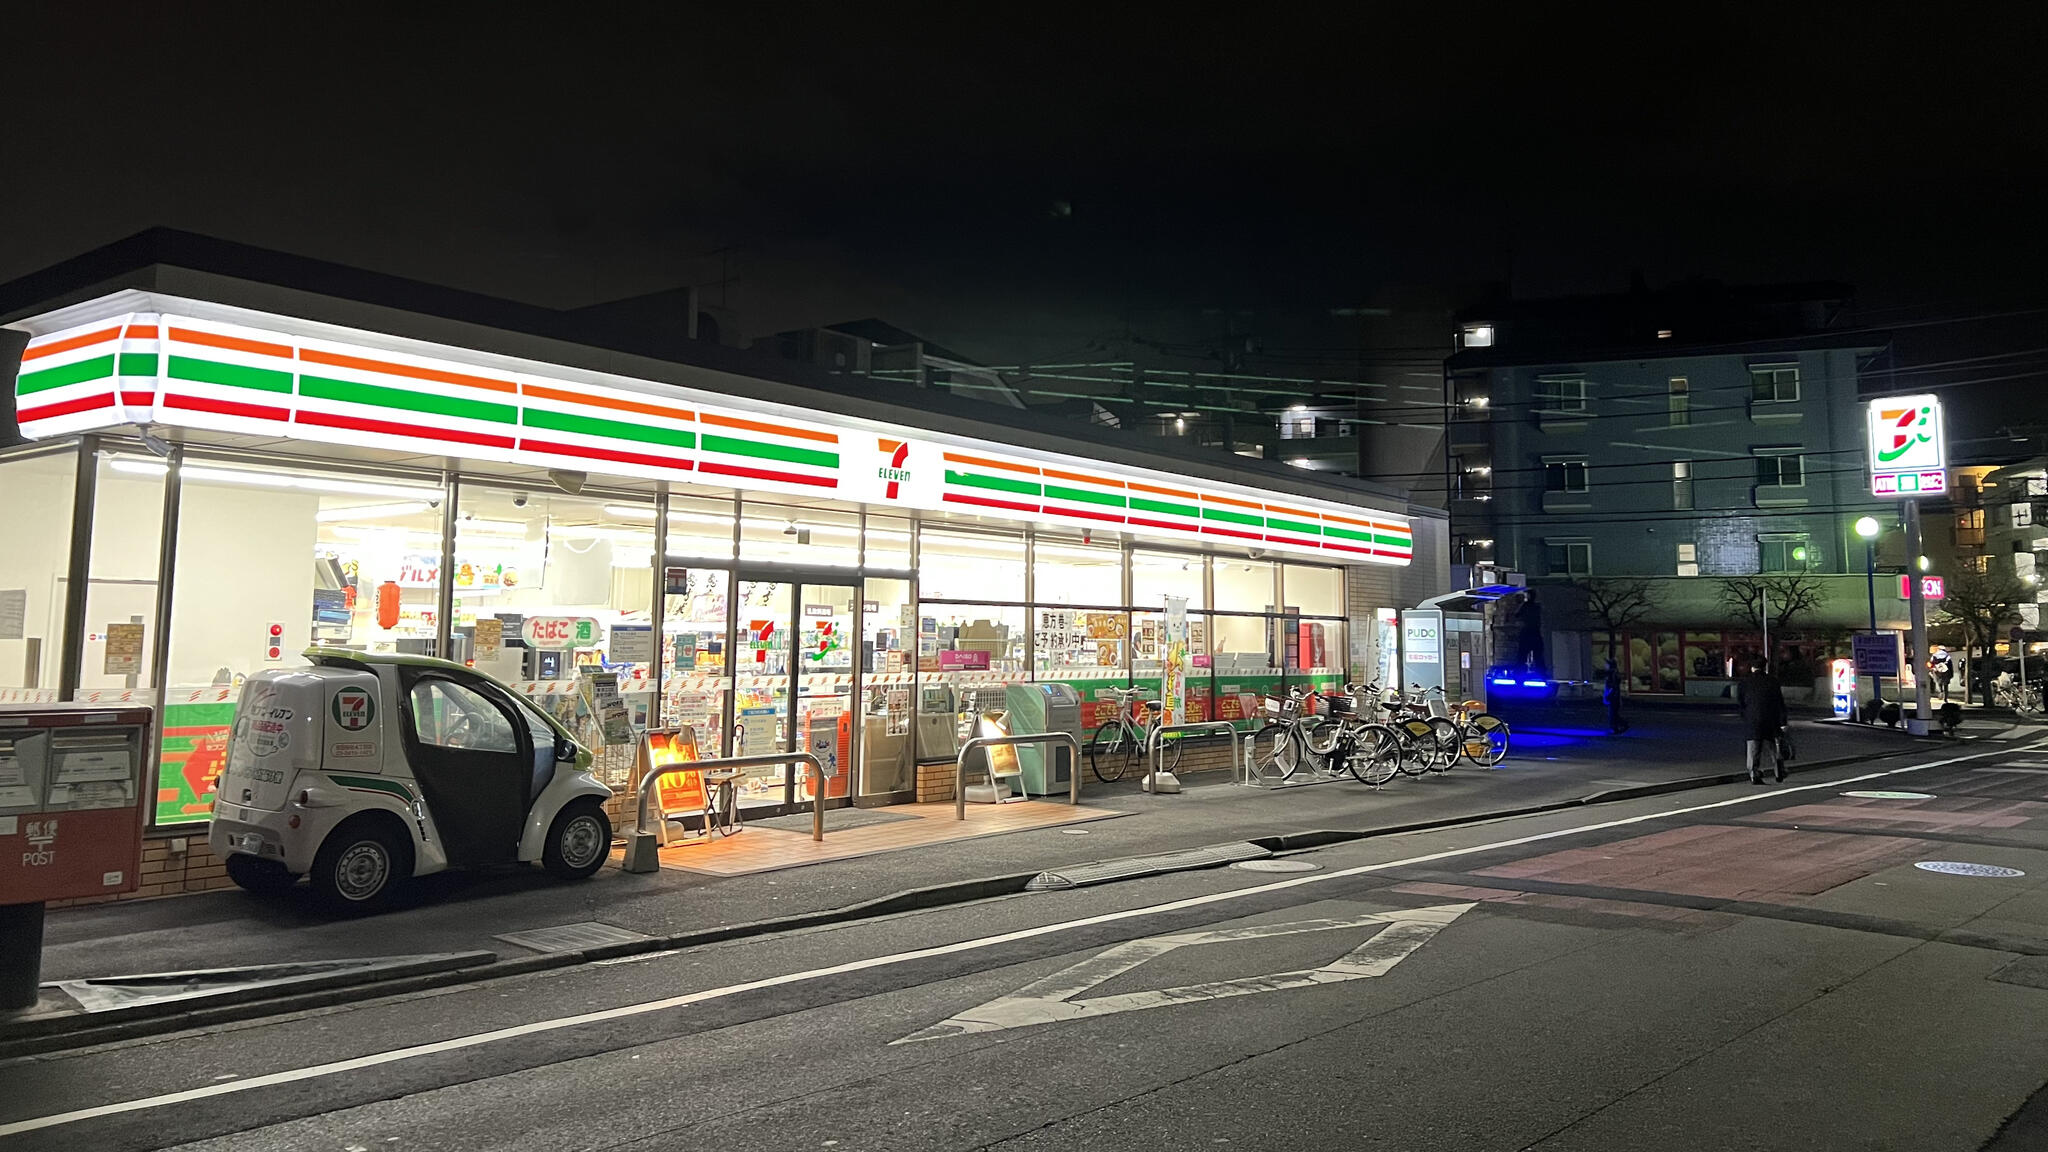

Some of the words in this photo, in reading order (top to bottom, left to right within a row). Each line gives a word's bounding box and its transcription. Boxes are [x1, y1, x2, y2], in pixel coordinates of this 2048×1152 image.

[532, 620, 569, 639] たばこ
[575, 621, 592, 640] 酒
[1407, 628, 1437, 638] PUDO
[25, 820, 58, 838] 郵便
[22, 851, 55, 867] POST
